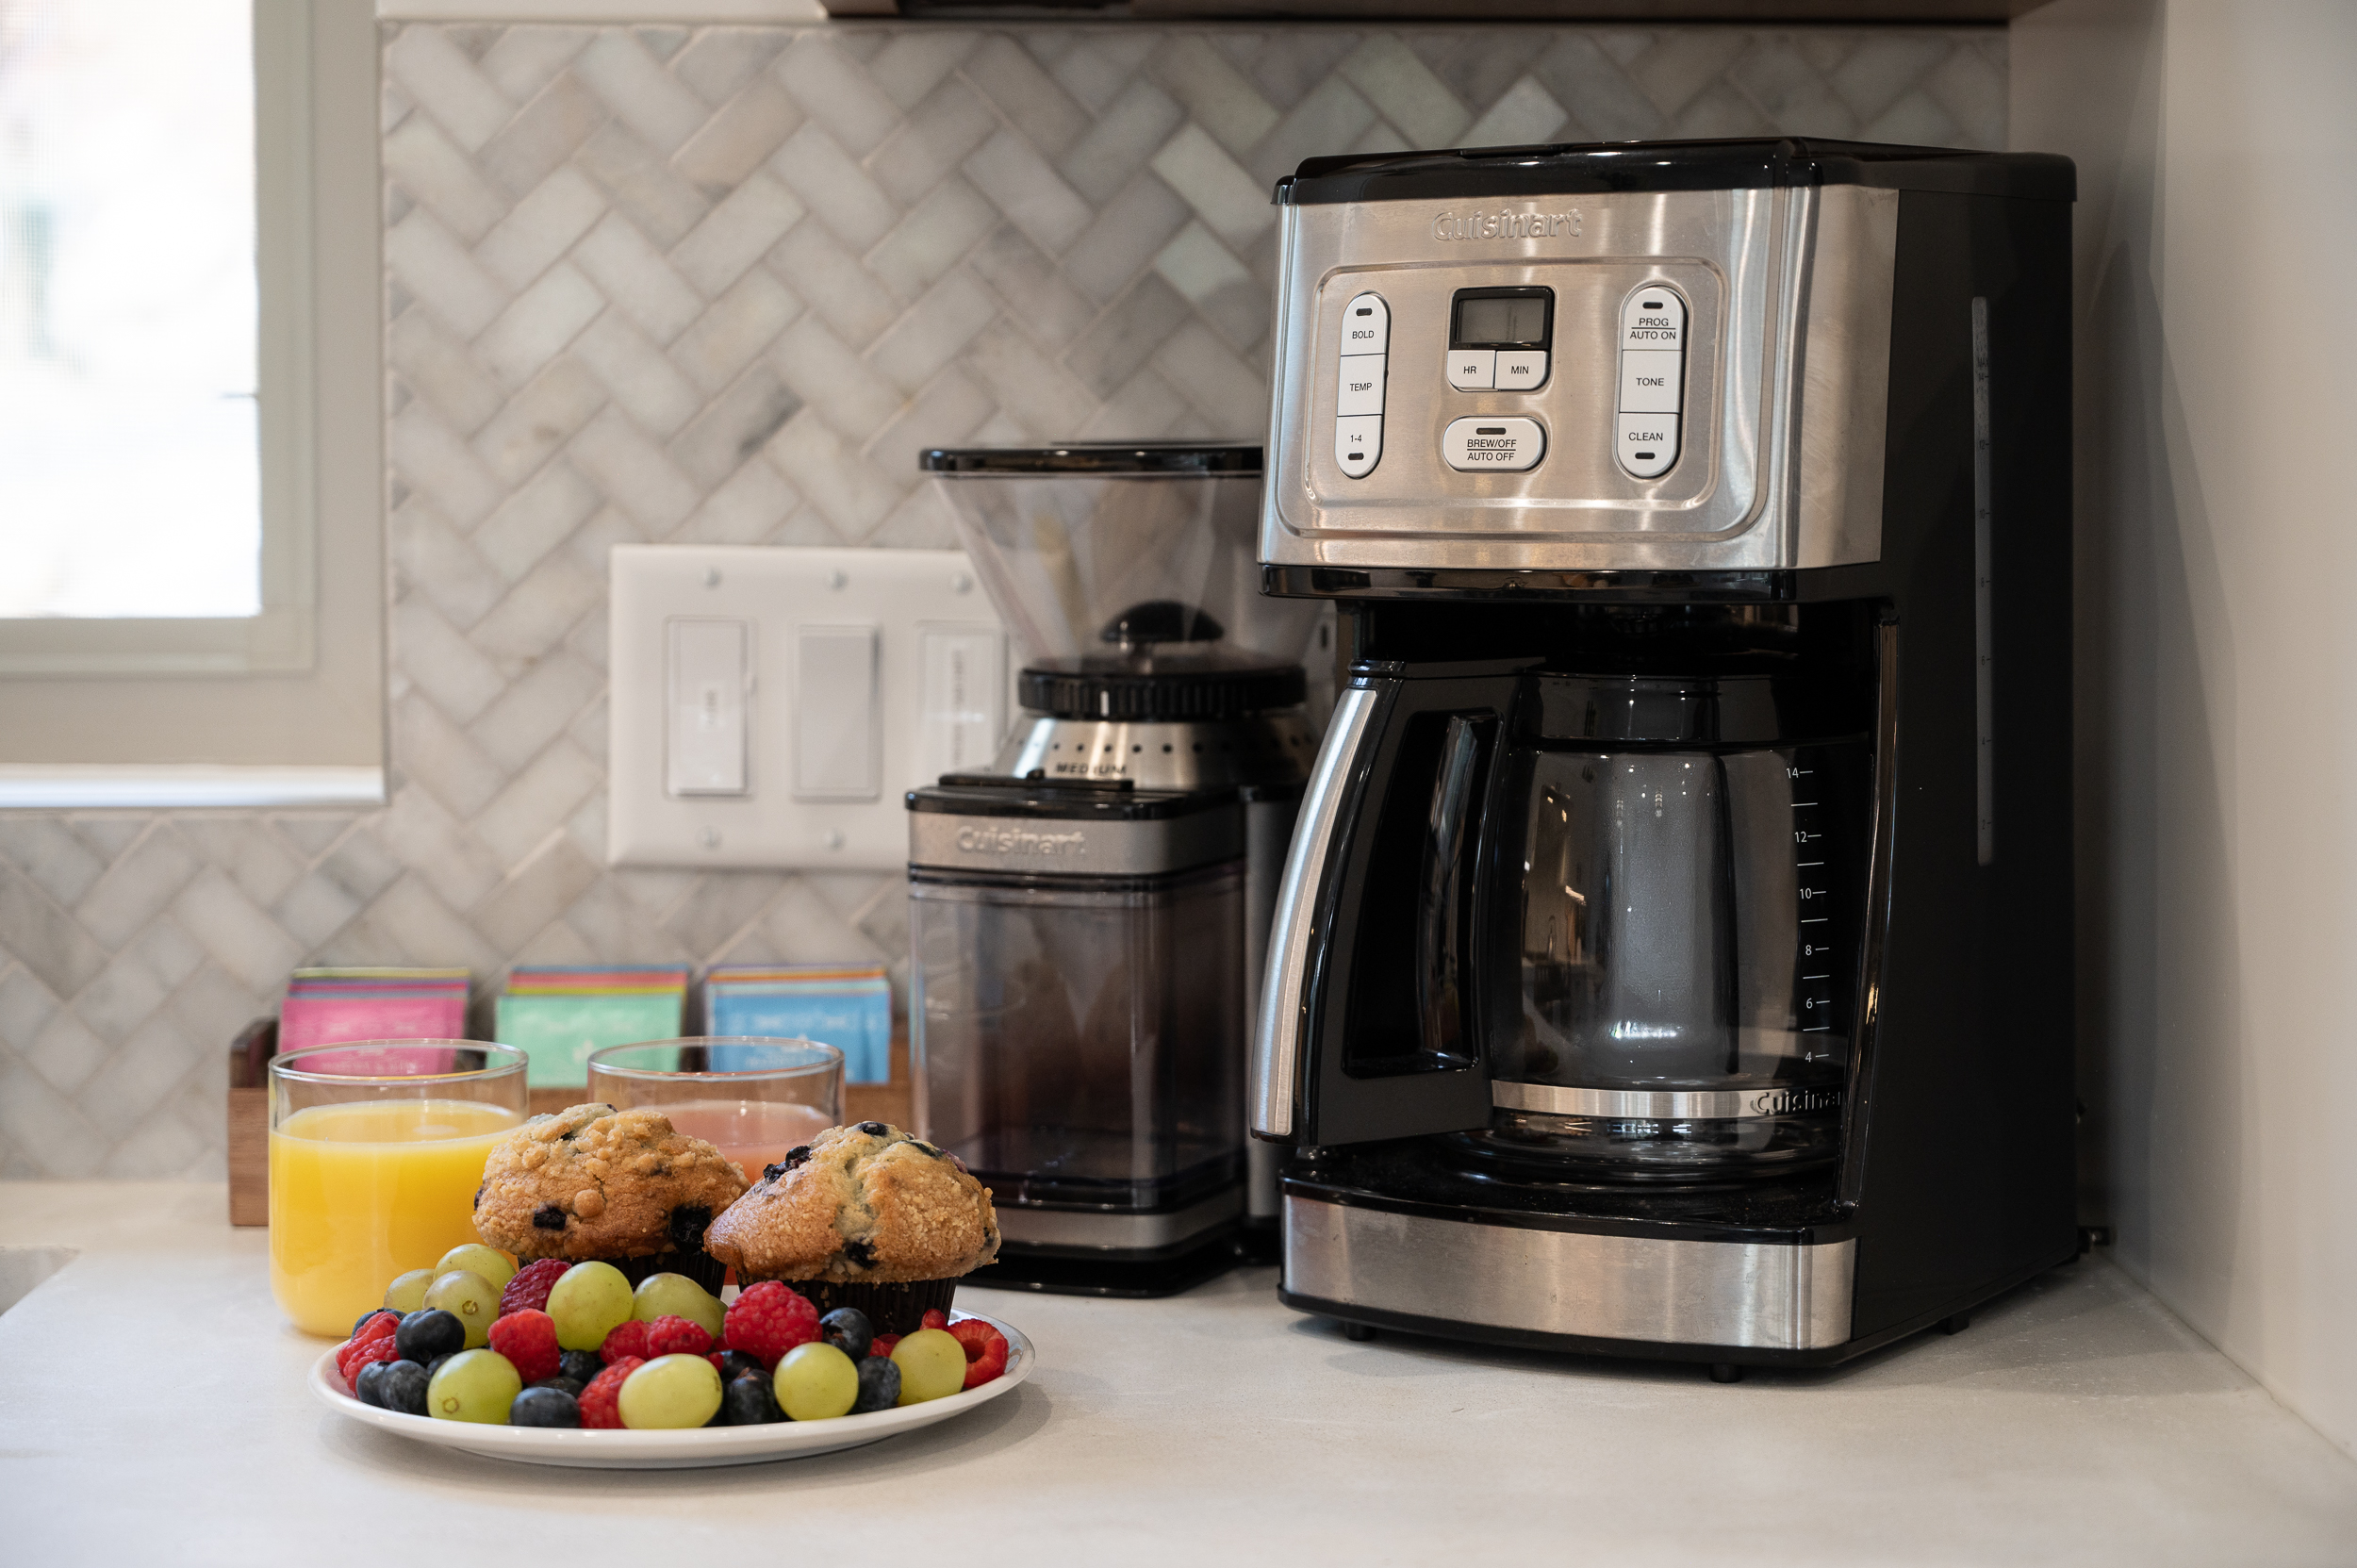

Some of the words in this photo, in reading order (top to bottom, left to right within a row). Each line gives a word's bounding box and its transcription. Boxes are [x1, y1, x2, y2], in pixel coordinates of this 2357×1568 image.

[1432, 208, 1583, 241] Cuisinart
[1639, 317, 1669, 327] PROG
[1352, 330, 1375, 339] BOLD
[1629, 331, 1658, 340] AUTO
[1660, 331, 1676, 340] ON
[1463, 366, 1477, 374] HR
[1510, 366, 1529, 374] MIN
[1349, 382, 1373, 392] TEMP
[1636, 377, 1665, 387] TONE
[1350, 434, 1362, 443] 1-4
[1628, 432, 1663, 441] CLEAN
[1467, 438, 1517, 448] BREW/OFF
[1979, 439, 1986, 450] 12
[1467, 452, 1493, 461] AUTO
[1496, 452, 1515, 461] OFF
[1979, 508, 1986, 520] 10
[1980, 576, 1986, 587] 8
[1981, 654, 1986, 666] 6
[1786, 767, 1799, 779] 14
[957, 825, 1085, 855] Cuisinart
[1794, 831, 1807, 843] 12
[1799, 887, 1812, 900] 10
[1805, 944, 1812, 956] 8
[1805, 997, 1813, 1009] 6
[1805, 1051, 1812, 1063] 4
